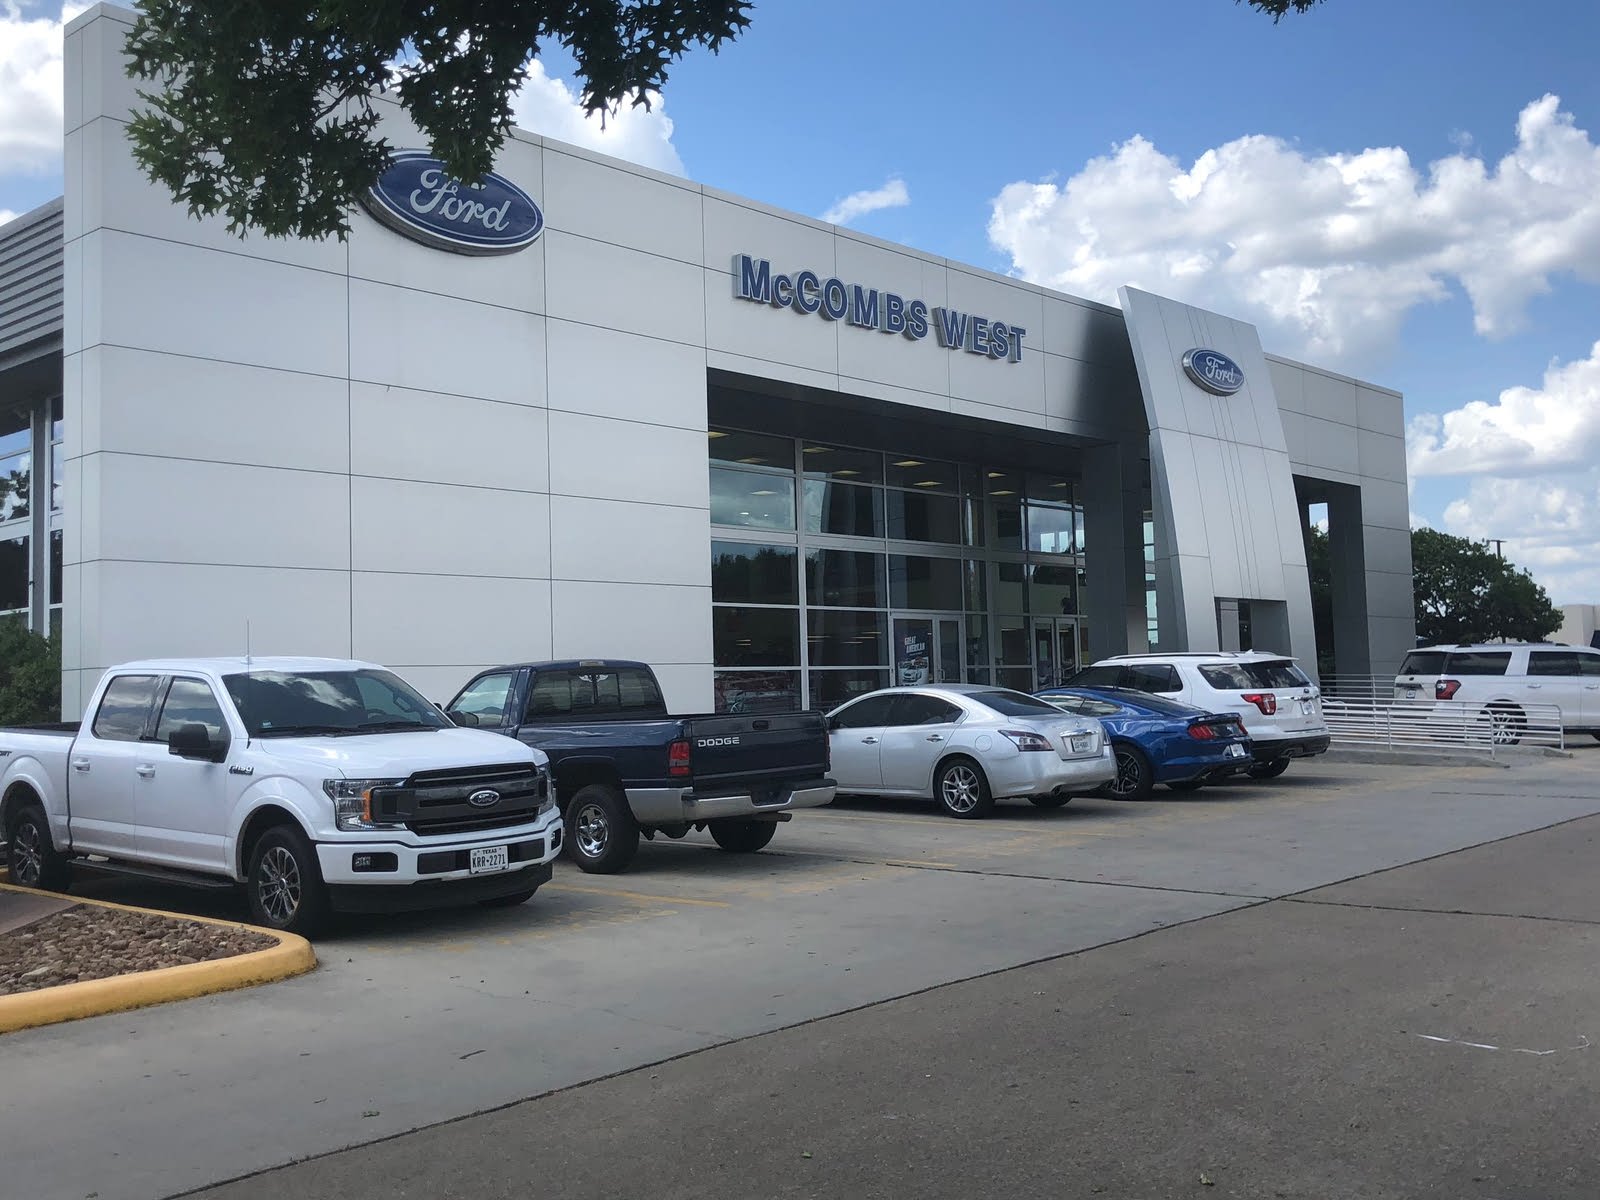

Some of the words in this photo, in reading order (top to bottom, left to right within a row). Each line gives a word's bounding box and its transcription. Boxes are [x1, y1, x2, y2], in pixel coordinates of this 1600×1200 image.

[409, 168, 512, 231] Ford
[932, 306, 1026, 363] WEST
[1205, 356, 1235, 384] Ford
[697, 736, 740, 748] DODGE
